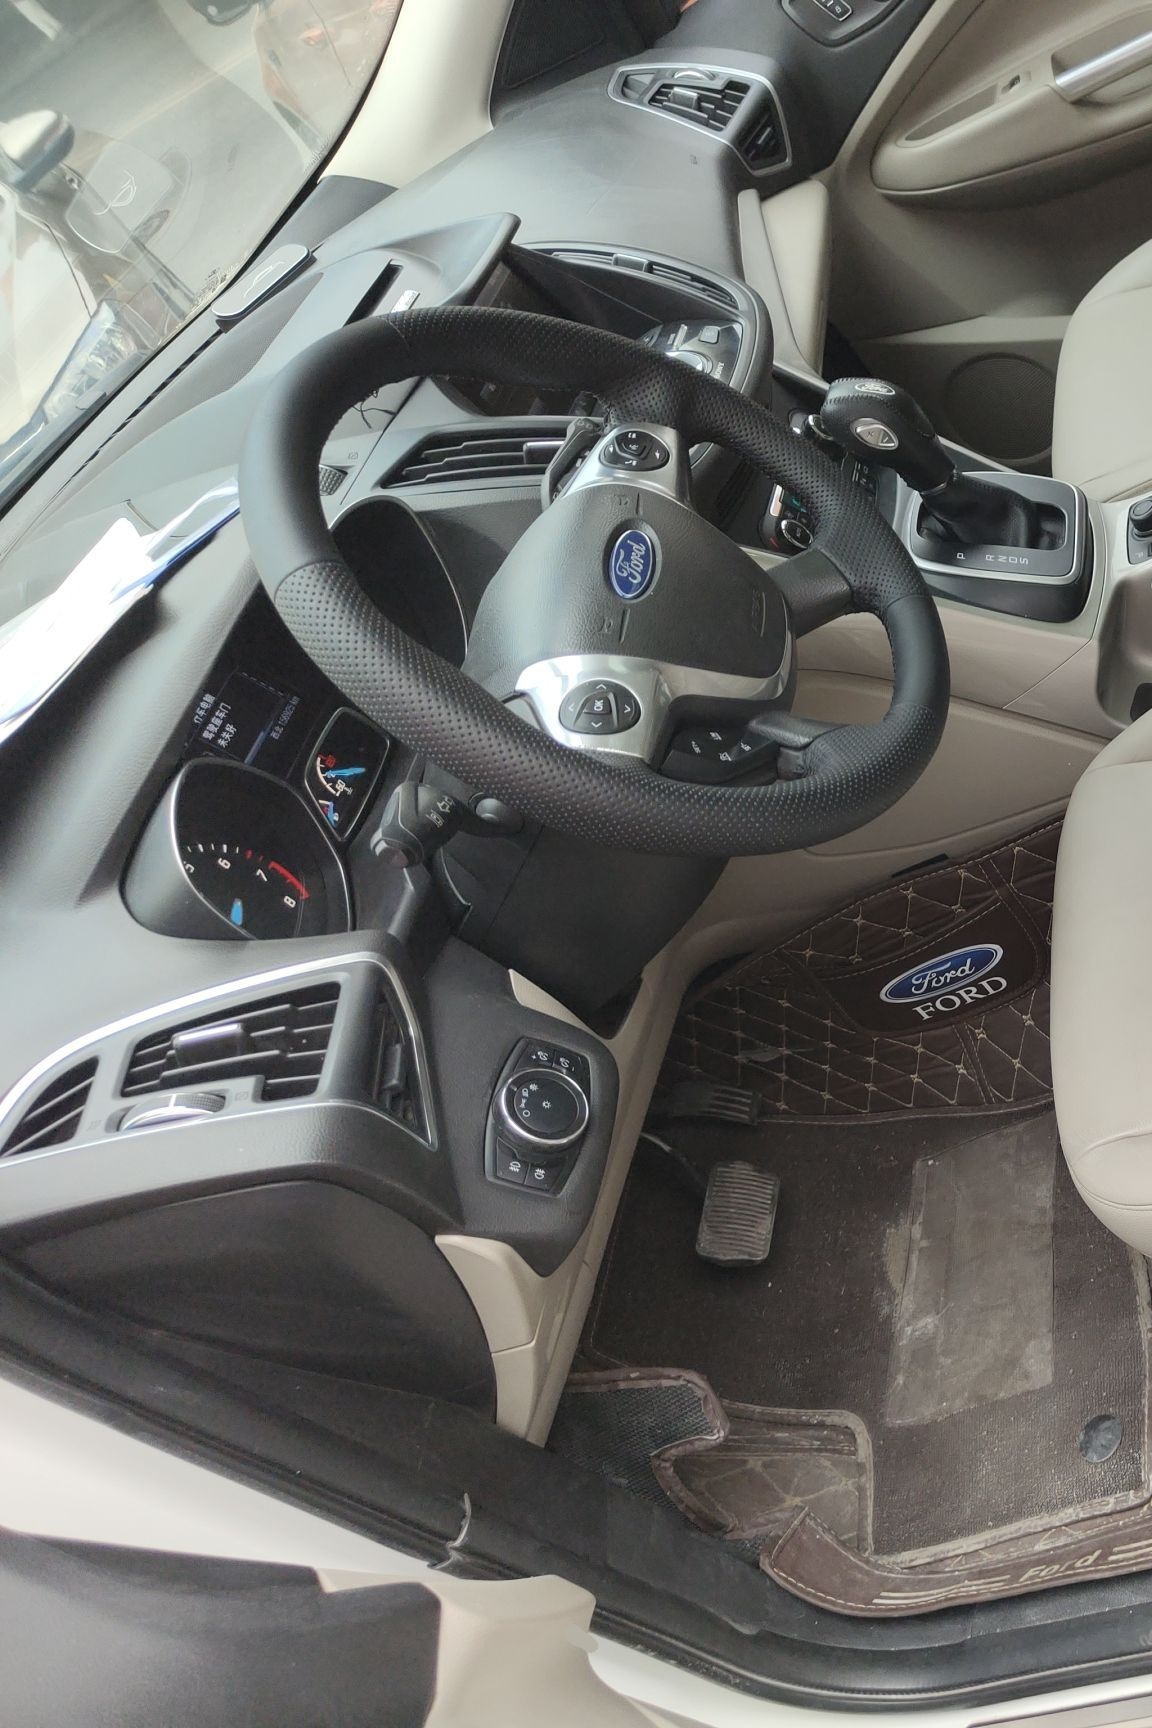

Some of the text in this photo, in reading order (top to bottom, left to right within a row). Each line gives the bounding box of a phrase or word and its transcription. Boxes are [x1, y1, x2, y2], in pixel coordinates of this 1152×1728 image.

[615, 539, 647, 584] Ford
[956, 552, 966, 560] P
[593, 699, 604, 712] OK
[217, 857, 231, 870] 6
[256, 868, 268, 882] 7
[283, 895, 297, 908] 8
[911, 956, 976, 995] Ford
[912, 976, 1009, 1021] FORD
[1018, 1548, 1103, 1582] Ford
